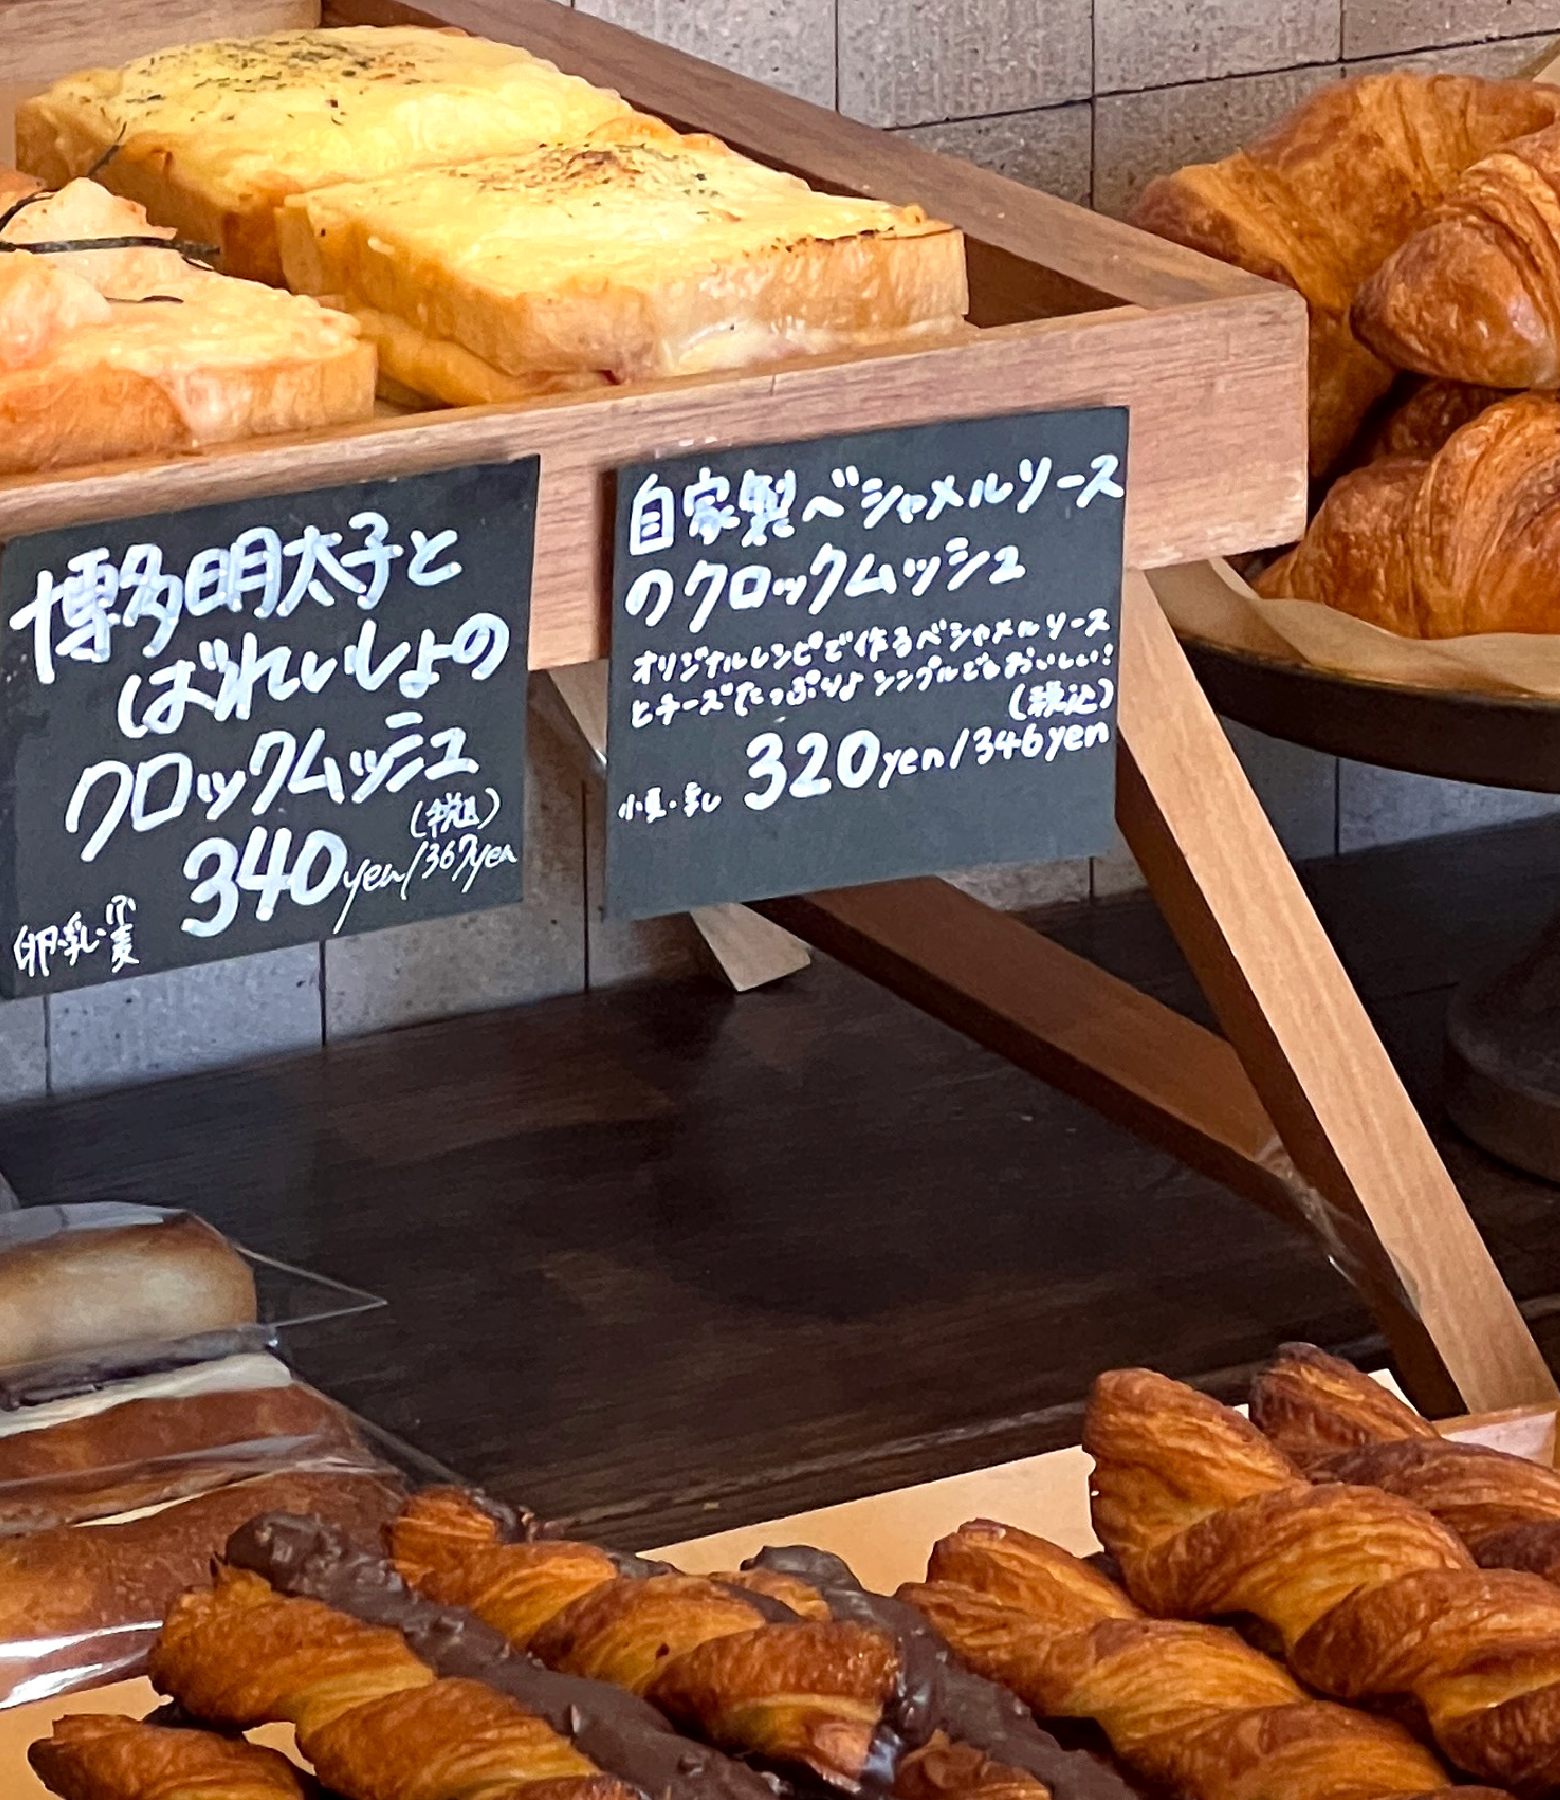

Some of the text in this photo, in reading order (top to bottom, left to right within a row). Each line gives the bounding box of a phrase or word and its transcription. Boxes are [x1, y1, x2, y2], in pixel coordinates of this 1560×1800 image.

[10, 512, 462, 683] 博多明太子と
[626, 538, 1026, 632] のクロックムッシュ
[118, 613, 510, 738] ばれいしょの
[66, 712, 479, 862] クロックムッシュ
